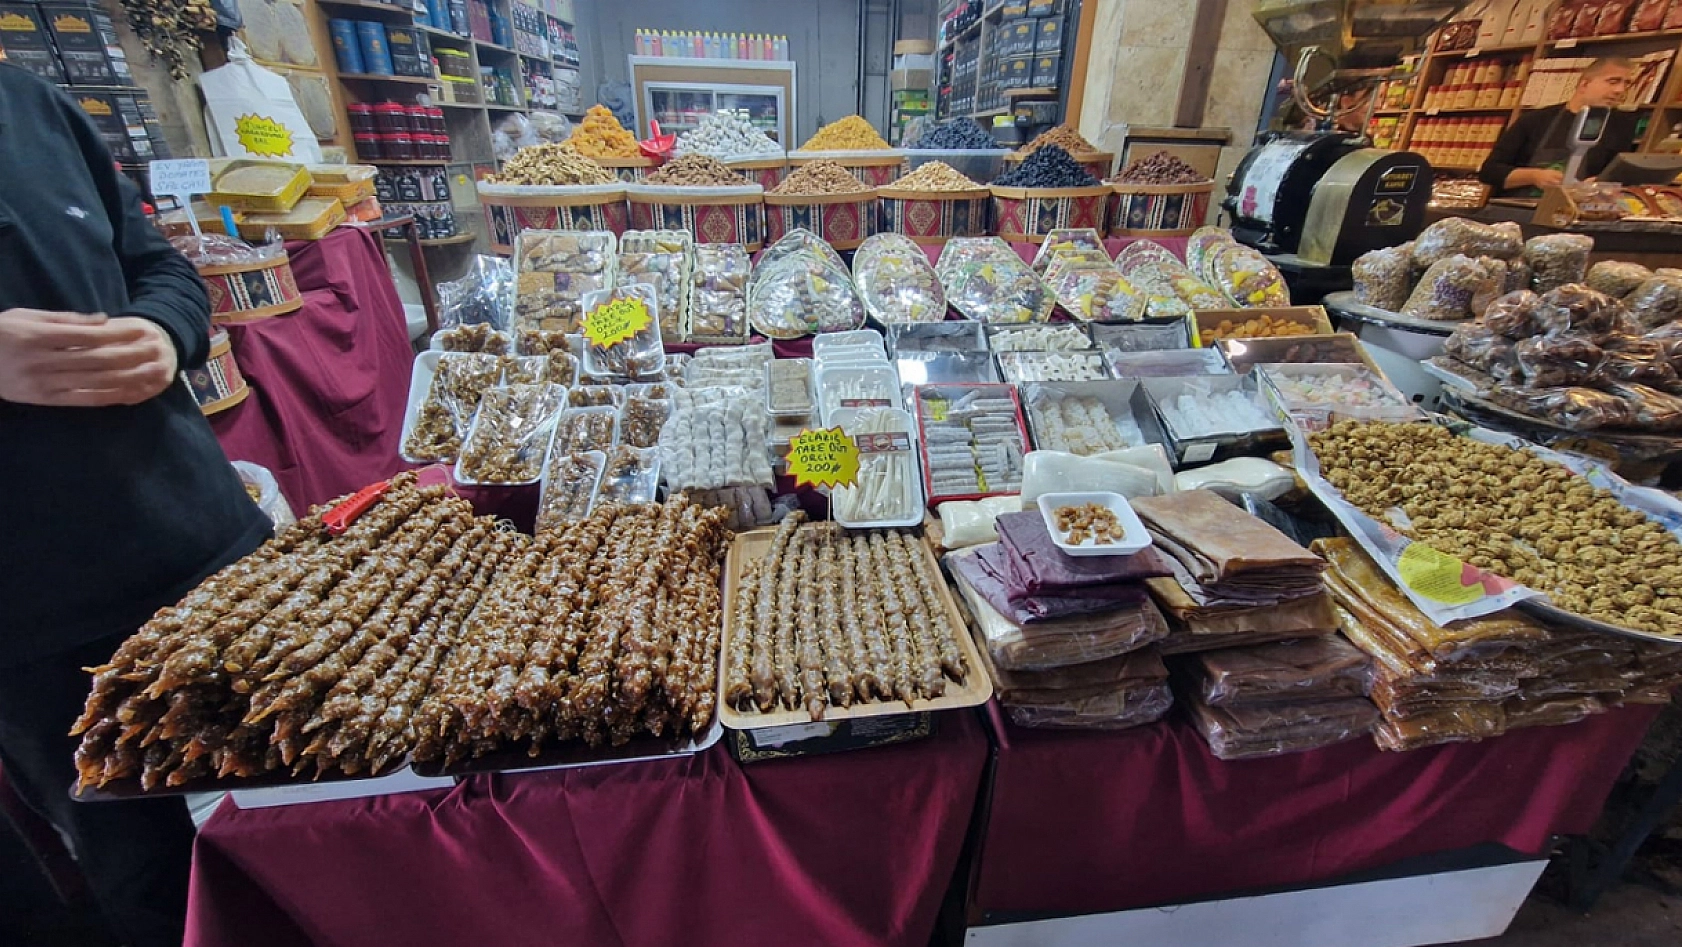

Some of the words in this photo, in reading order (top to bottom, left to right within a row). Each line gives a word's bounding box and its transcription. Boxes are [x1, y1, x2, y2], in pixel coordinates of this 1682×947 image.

[155, 162, 170, 170] EV
[159, 170, 206, 179] DOMATES
[794, 443, 825, 454] TAZE
